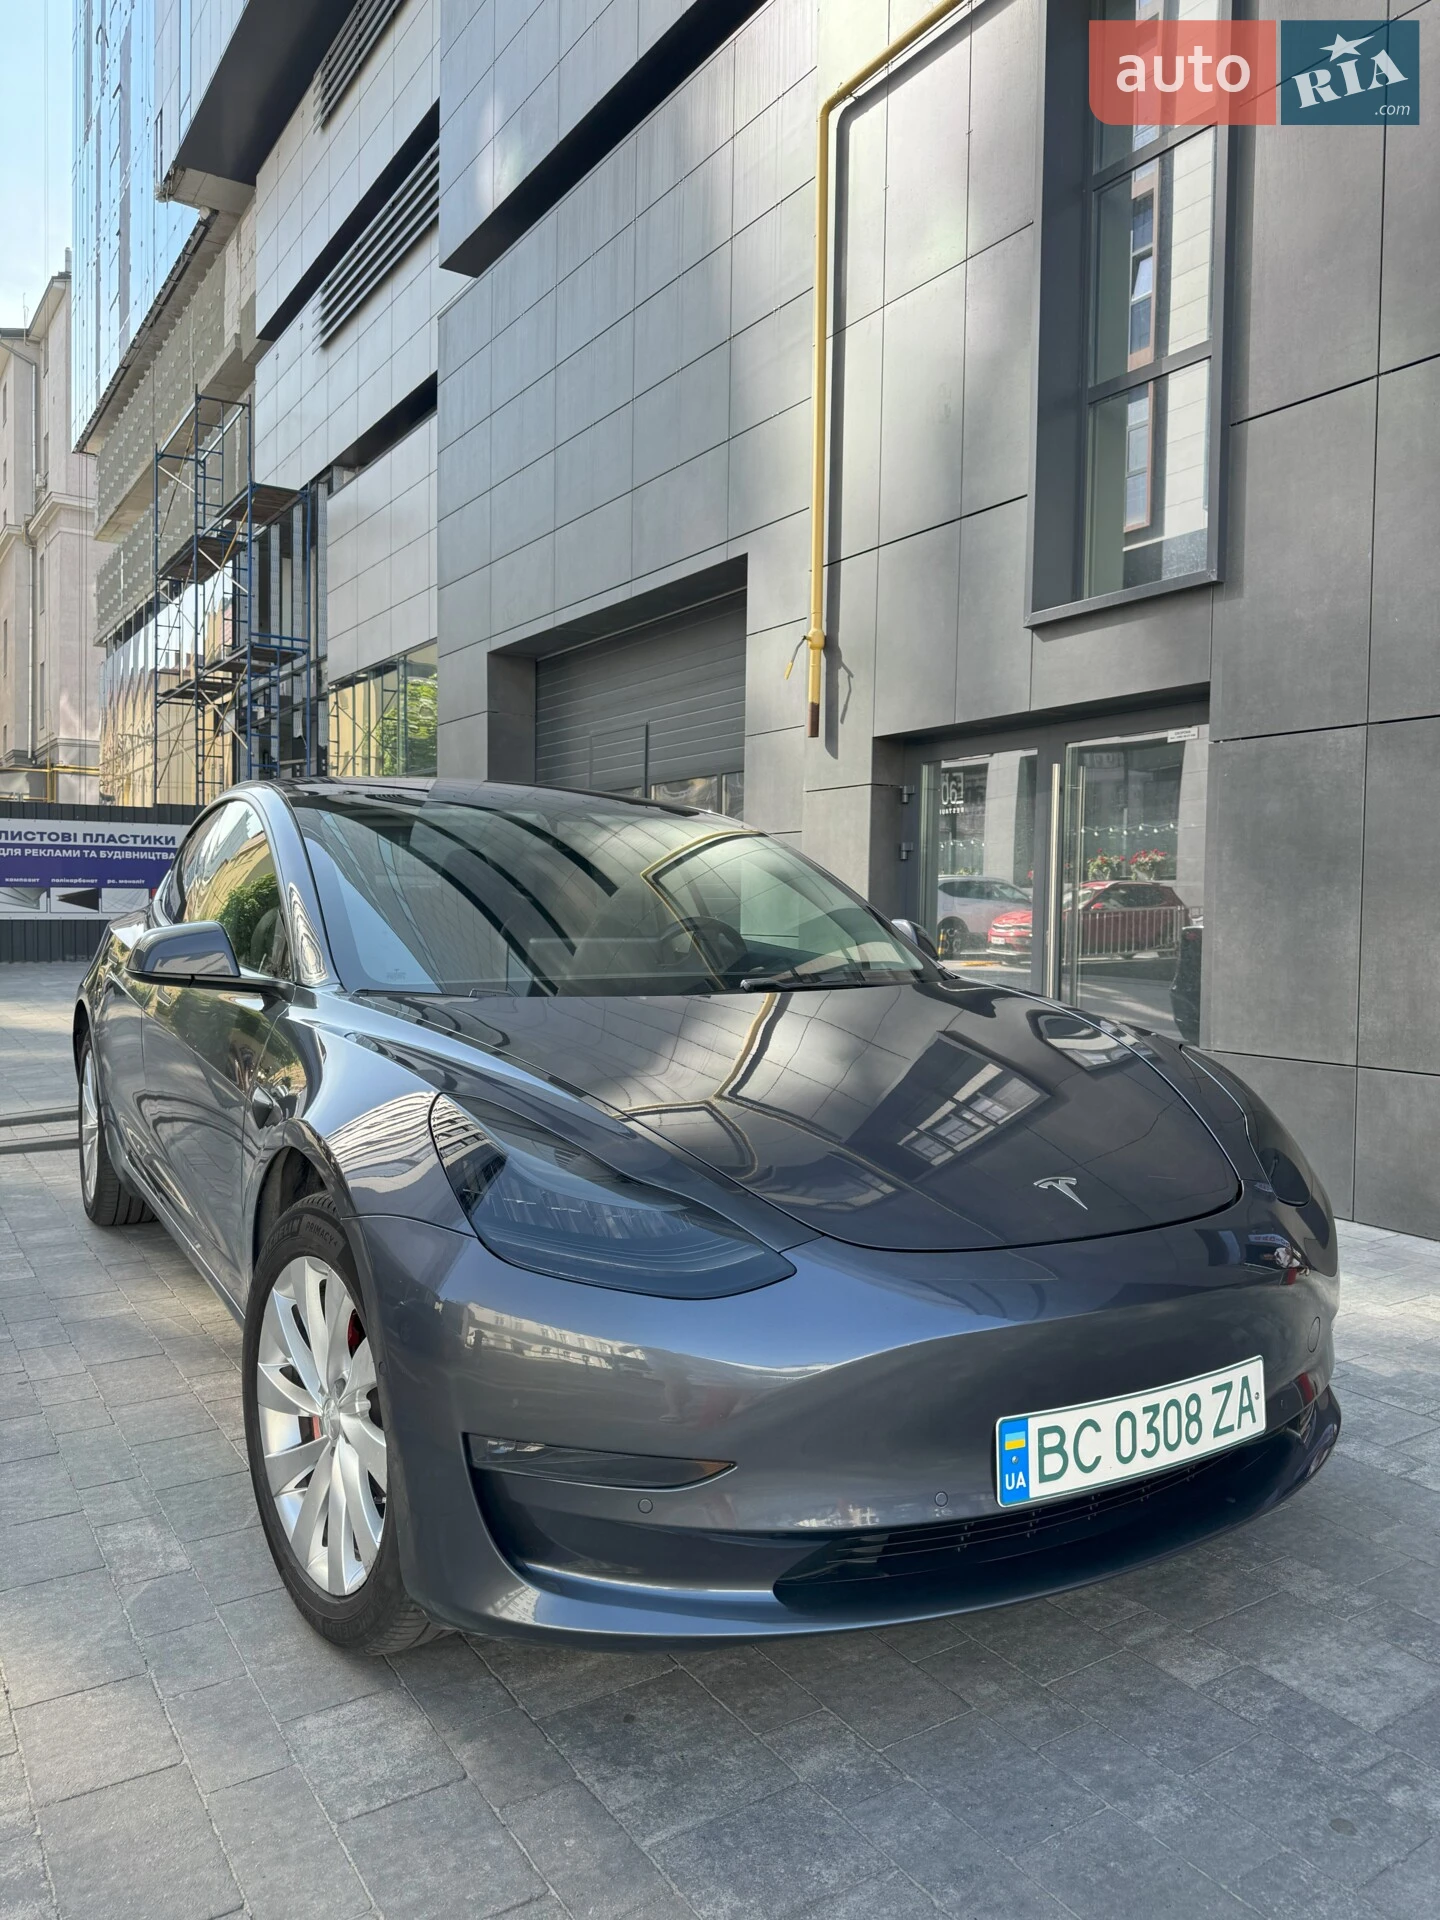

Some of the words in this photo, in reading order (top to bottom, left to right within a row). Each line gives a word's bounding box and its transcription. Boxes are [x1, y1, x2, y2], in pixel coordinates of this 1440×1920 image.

[0, 830, 77, 843] ЛИСТОВІ
[83, 833, 176, 846] ПЛАСТИКИ
[0, 847, 22, 857] ДЛЯ
[24, 848, 81, 858] РЕКЛАМИ
[82, 849, 98, 858] ТА
[99, 850, 175, 860] БУДІВНИЦТВА
[305, 1221, 335, 1244] PRIMACY
[1037, 1418, 1102, 1484] BC
[1114, 1392, 1203, 1465] 0308
[1211, 1375, 1257, 1439] ZA
[1005, 1471, 1026, 1491] UA
